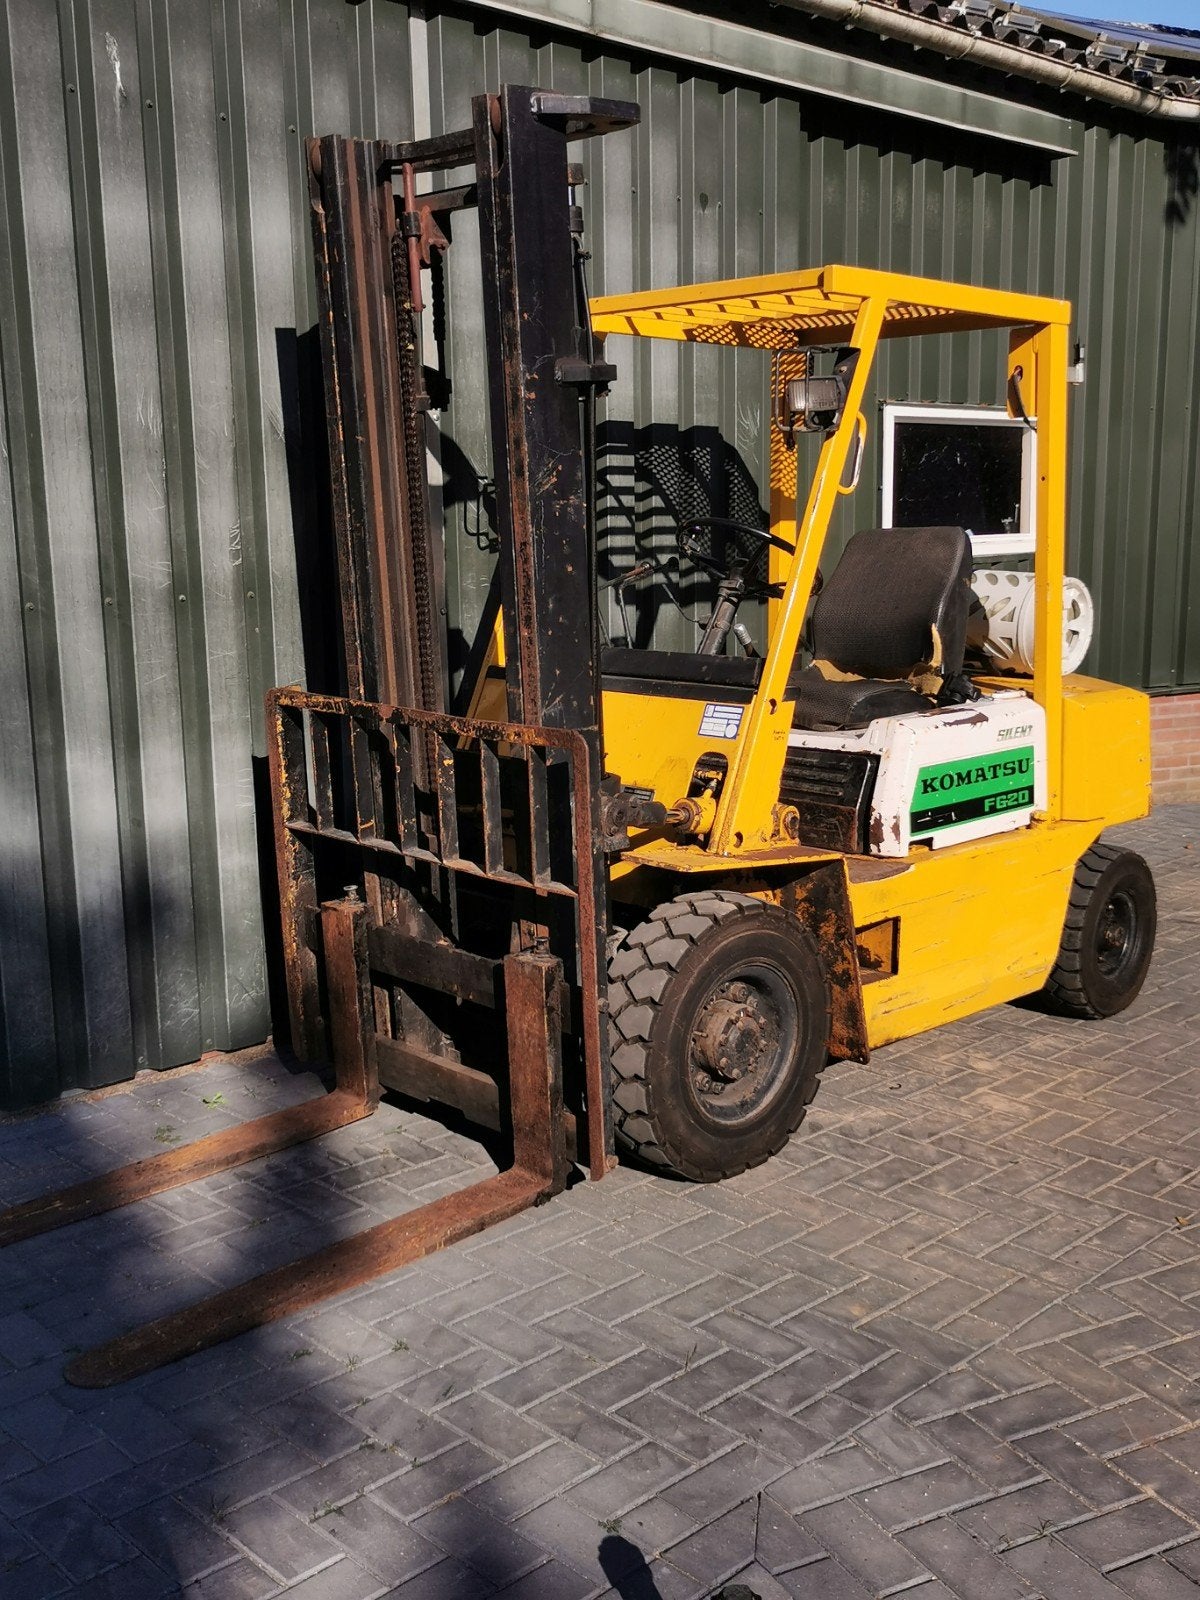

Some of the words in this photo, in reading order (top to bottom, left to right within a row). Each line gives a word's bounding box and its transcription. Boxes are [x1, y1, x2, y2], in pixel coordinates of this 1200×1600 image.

[997, 725, 1033, 741] SILENT
[921, 758, 1030, 794] KOMATSU
[984, 790, 1029, 812] FG20
